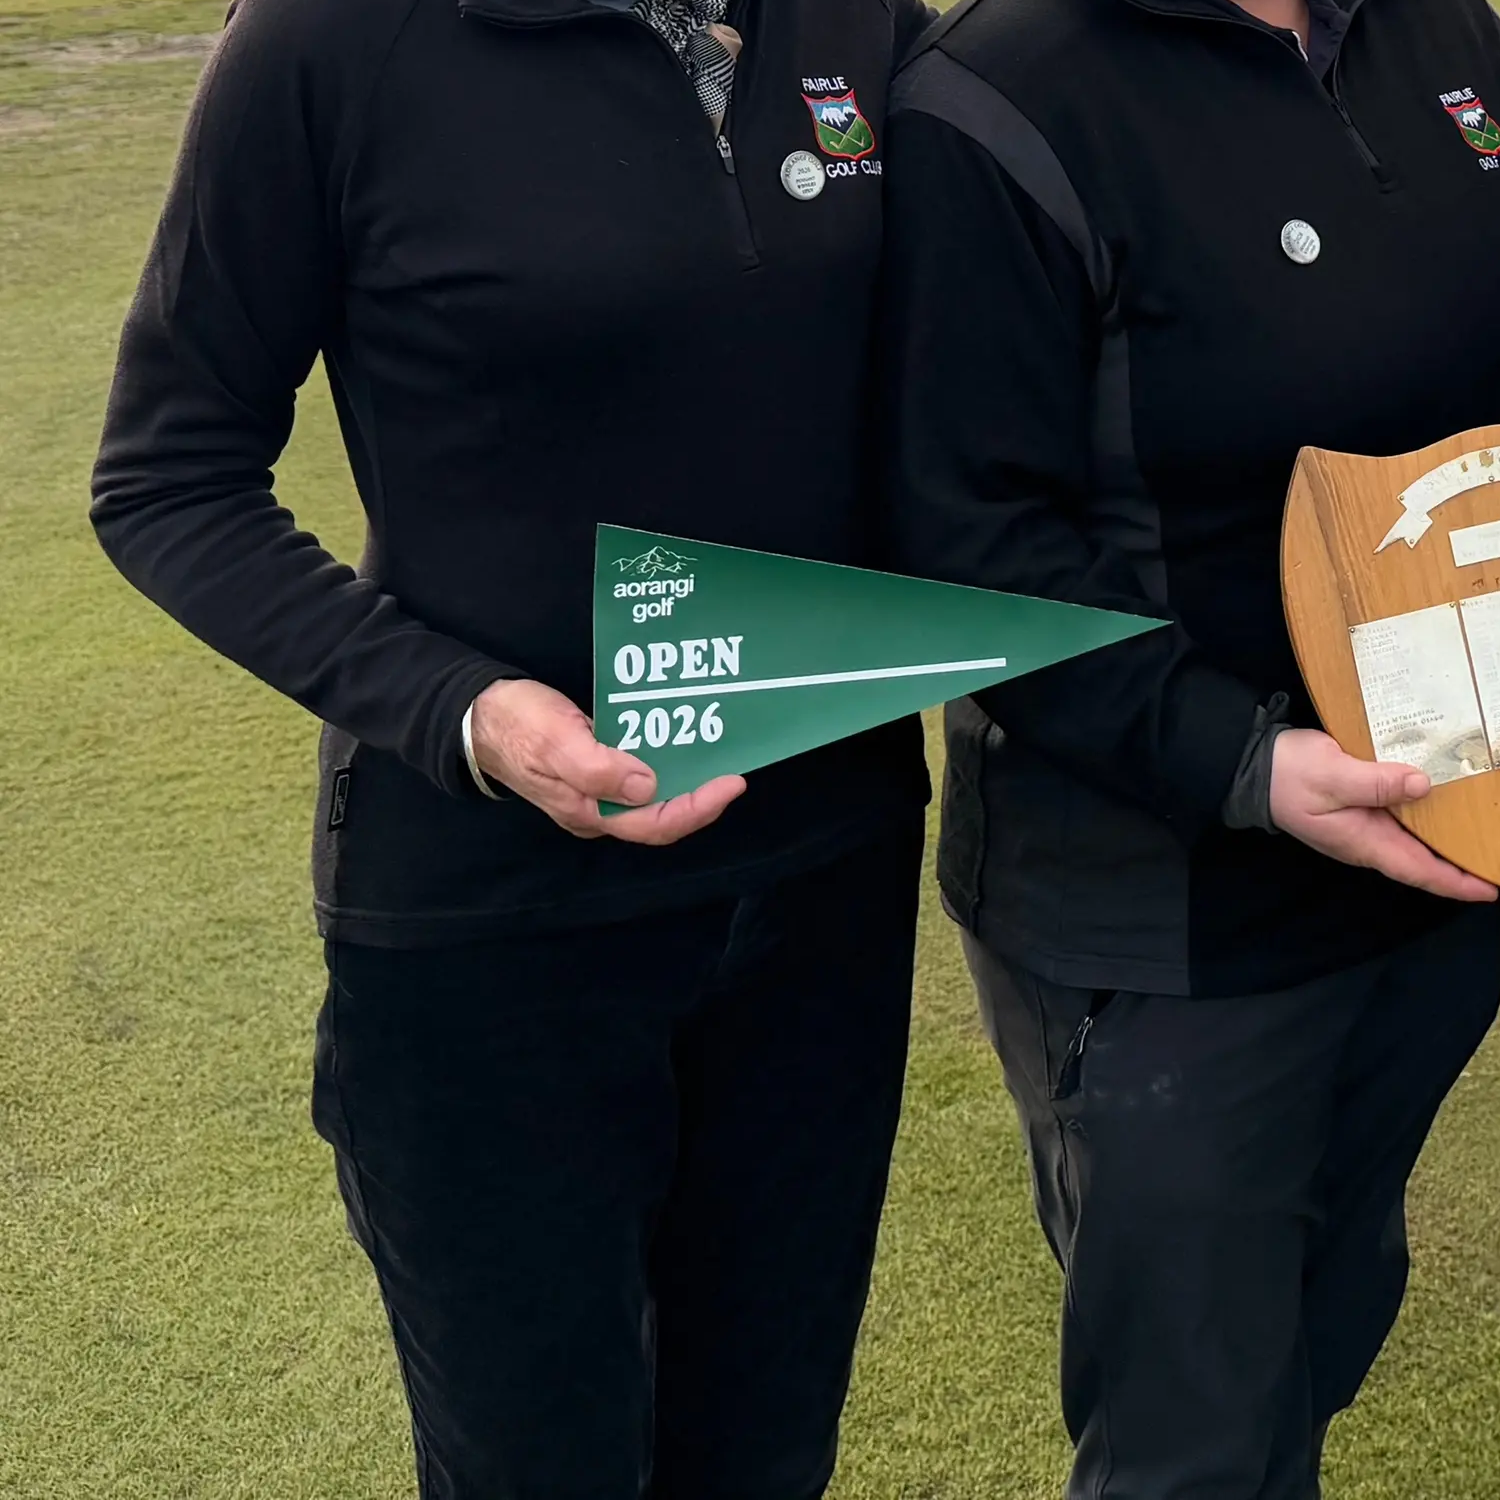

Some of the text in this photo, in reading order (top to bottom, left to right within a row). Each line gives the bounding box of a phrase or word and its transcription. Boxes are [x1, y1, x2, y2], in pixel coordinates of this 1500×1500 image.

[801, 76, 848, 91] FAIRLIE
[1439, 87, 1475, 106] FAIRLIE
[825, 160, 882, 178] GOLF CLUB
[613, 573, 695, 598] aorangi
[632, 597, 675, 623] golf
[614, 635, 743, 685] OPEN
[617, 701, 723, 750] 2026
